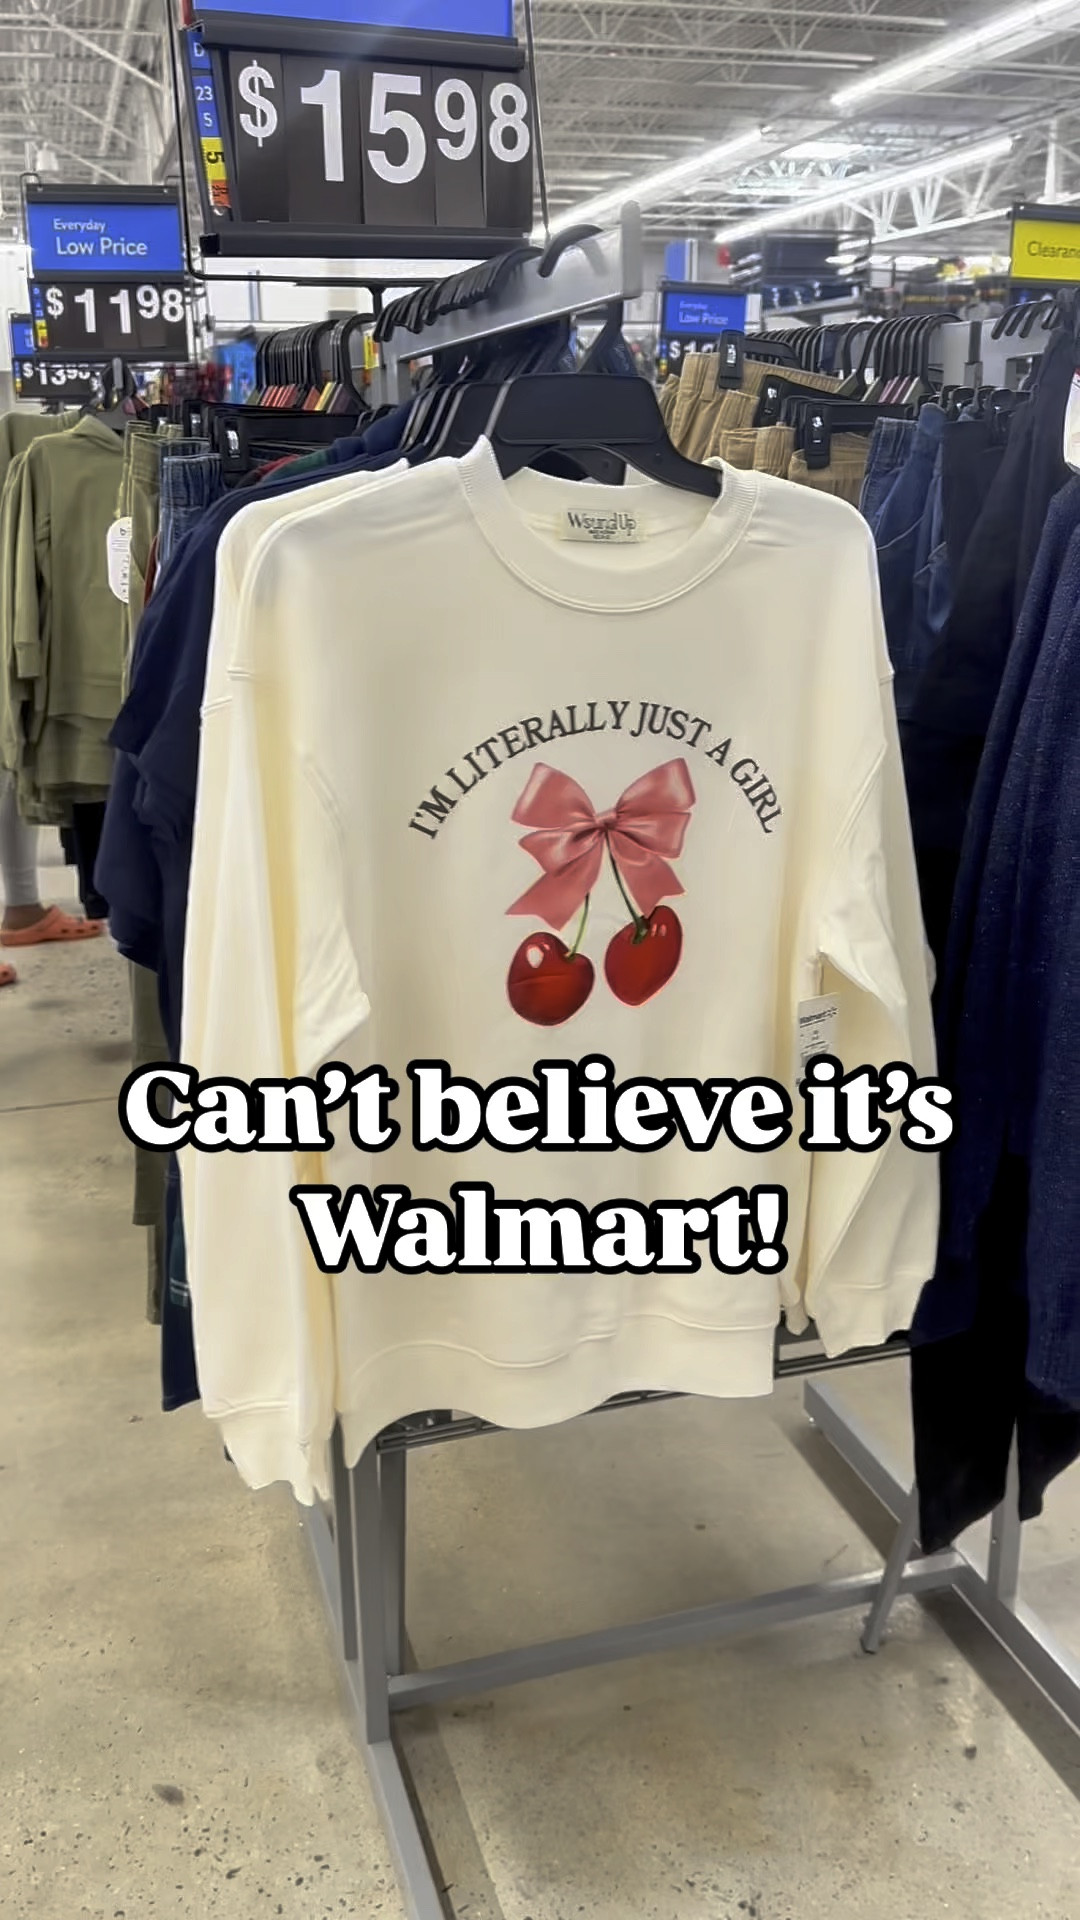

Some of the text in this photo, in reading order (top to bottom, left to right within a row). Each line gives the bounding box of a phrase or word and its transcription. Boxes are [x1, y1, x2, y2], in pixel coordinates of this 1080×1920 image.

[195, 86, 213, 101] 23
[203, 113, 213, 127] 5
[53, 218, 106, 233] Everyday
[56, 237, 148, 256] Low Price
[409, 700, 783, 840] I'M LITERALLY JUST A GIRL
